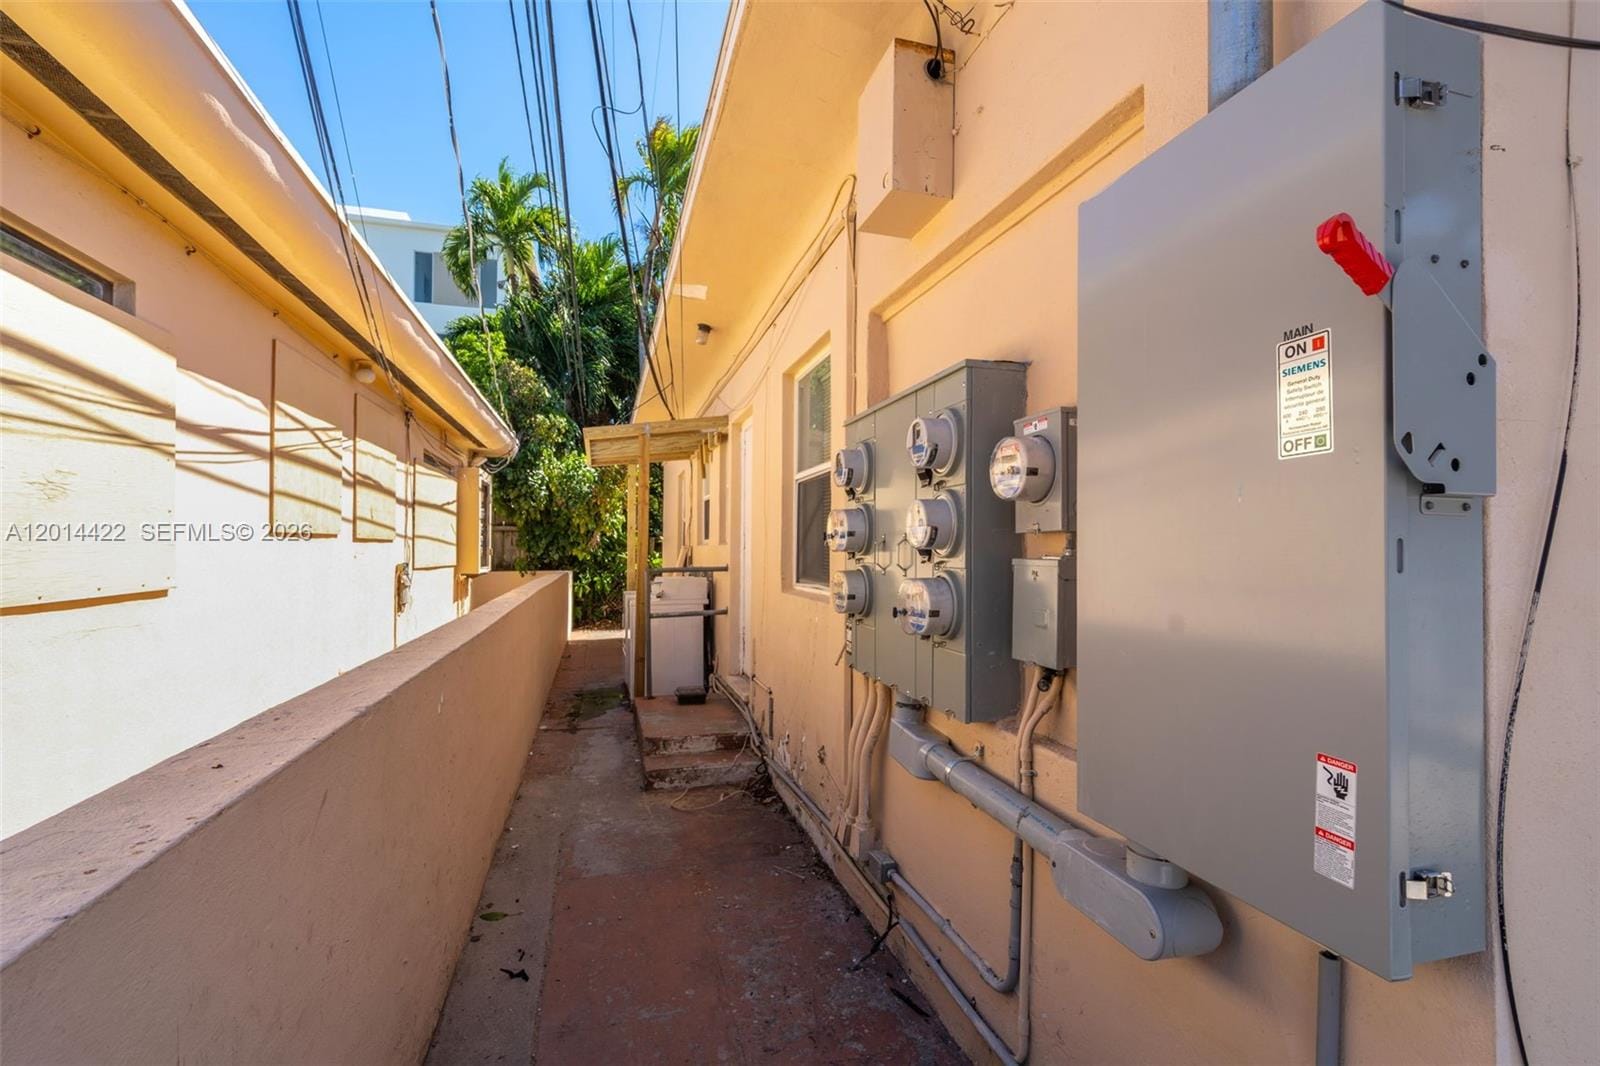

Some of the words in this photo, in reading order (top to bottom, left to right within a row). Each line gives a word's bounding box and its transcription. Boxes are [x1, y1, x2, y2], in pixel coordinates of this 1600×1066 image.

[1283, 323, 1314, 341] MAIN
[1284, 341, 1307, 359] ON
[1282, 358, 1327, 378] SIEMENS
[1283, 436, 1313, 453] OFF
[1327, 757, 1355, 772] DANGER
[1325, 832, 1352, 849] DANGER
